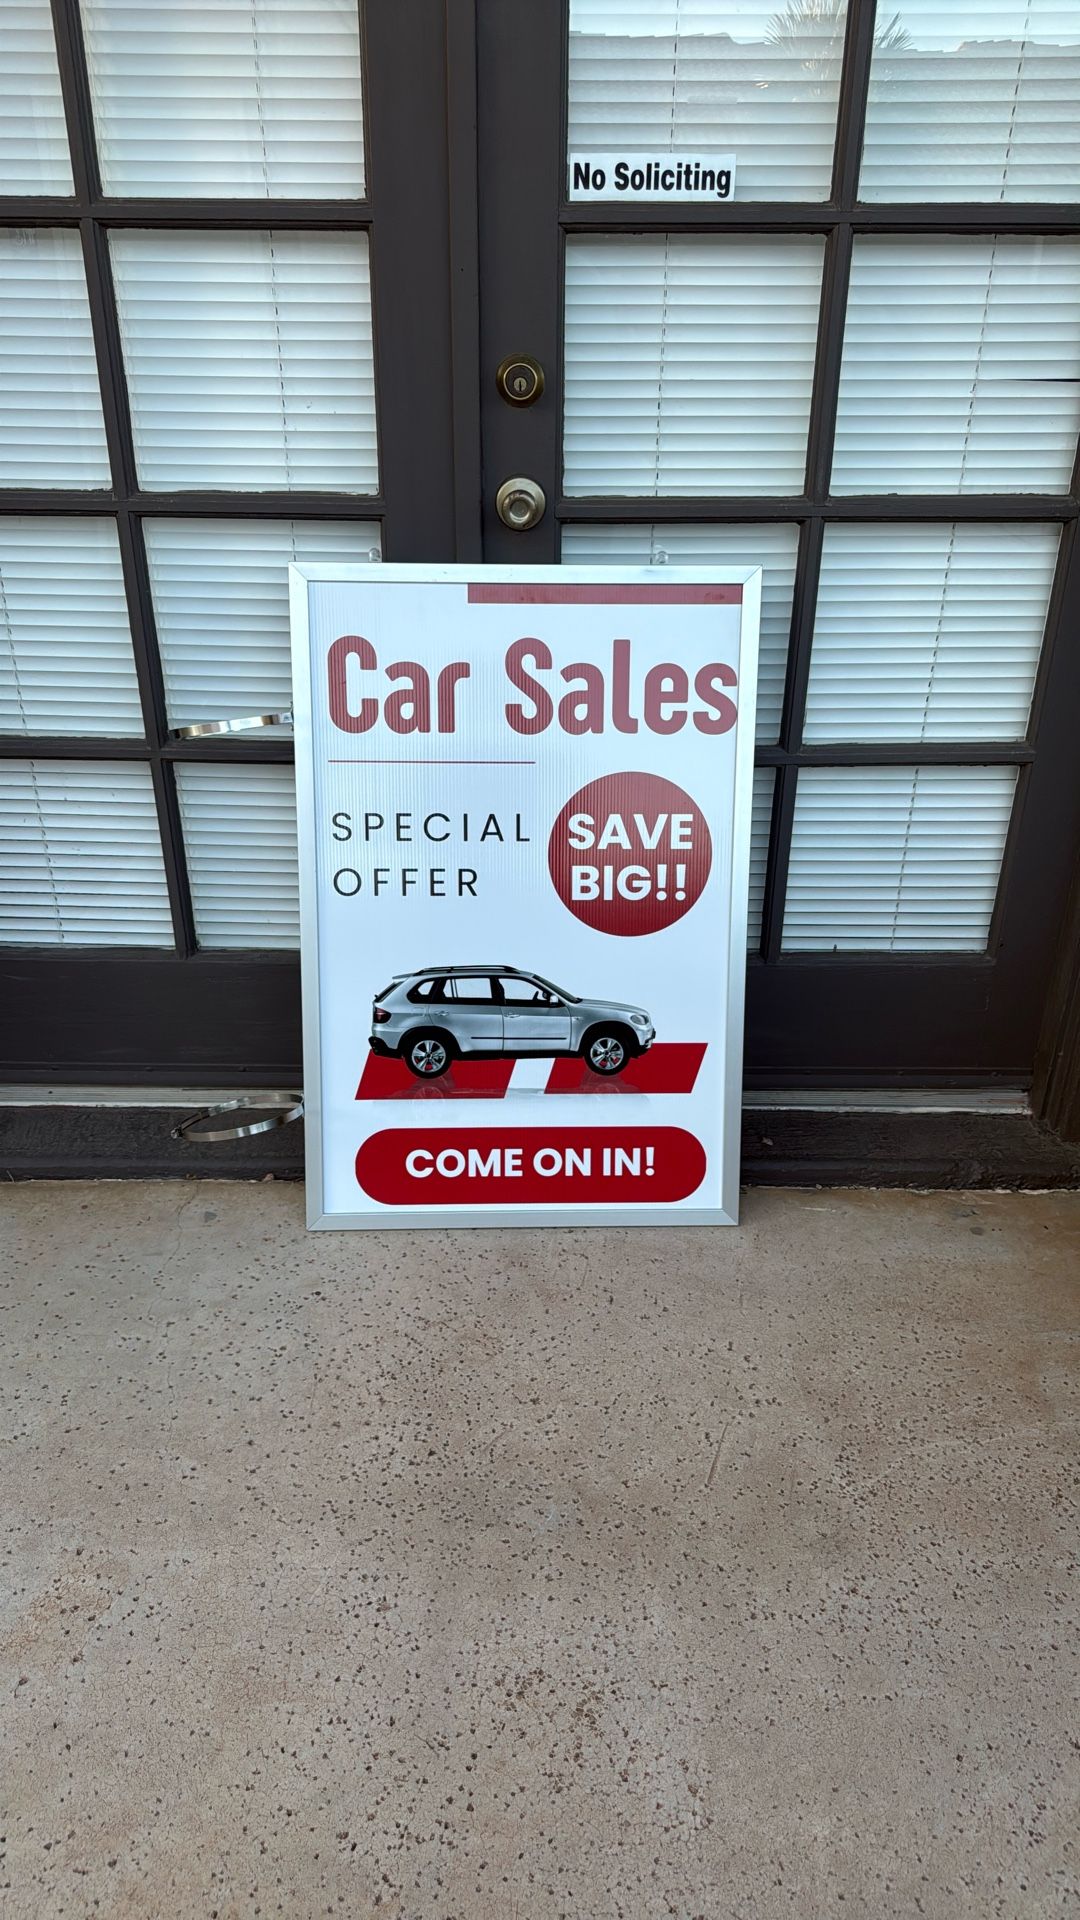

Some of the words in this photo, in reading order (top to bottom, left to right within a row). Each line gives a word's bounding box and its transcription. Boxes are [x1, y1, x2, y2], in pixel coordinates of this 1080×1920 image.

[573, 162, 606, 190] No
[614, 162, 731, 198] Soliciting
[327, 635, 471, 734] Car
[504, 637, 738, 735] Sales
[331, 812, 531, 843] SPECIAL
[567, 813, 694, 850] SAVE
[332, 867, 479, 897] OFFER
[570, 864, 687, 901] BIG!!
[405, 1148, 523, 1178] COME
[532, 1147, 591, 1177] ON
[602, 1146, 655, 1177] IN!
